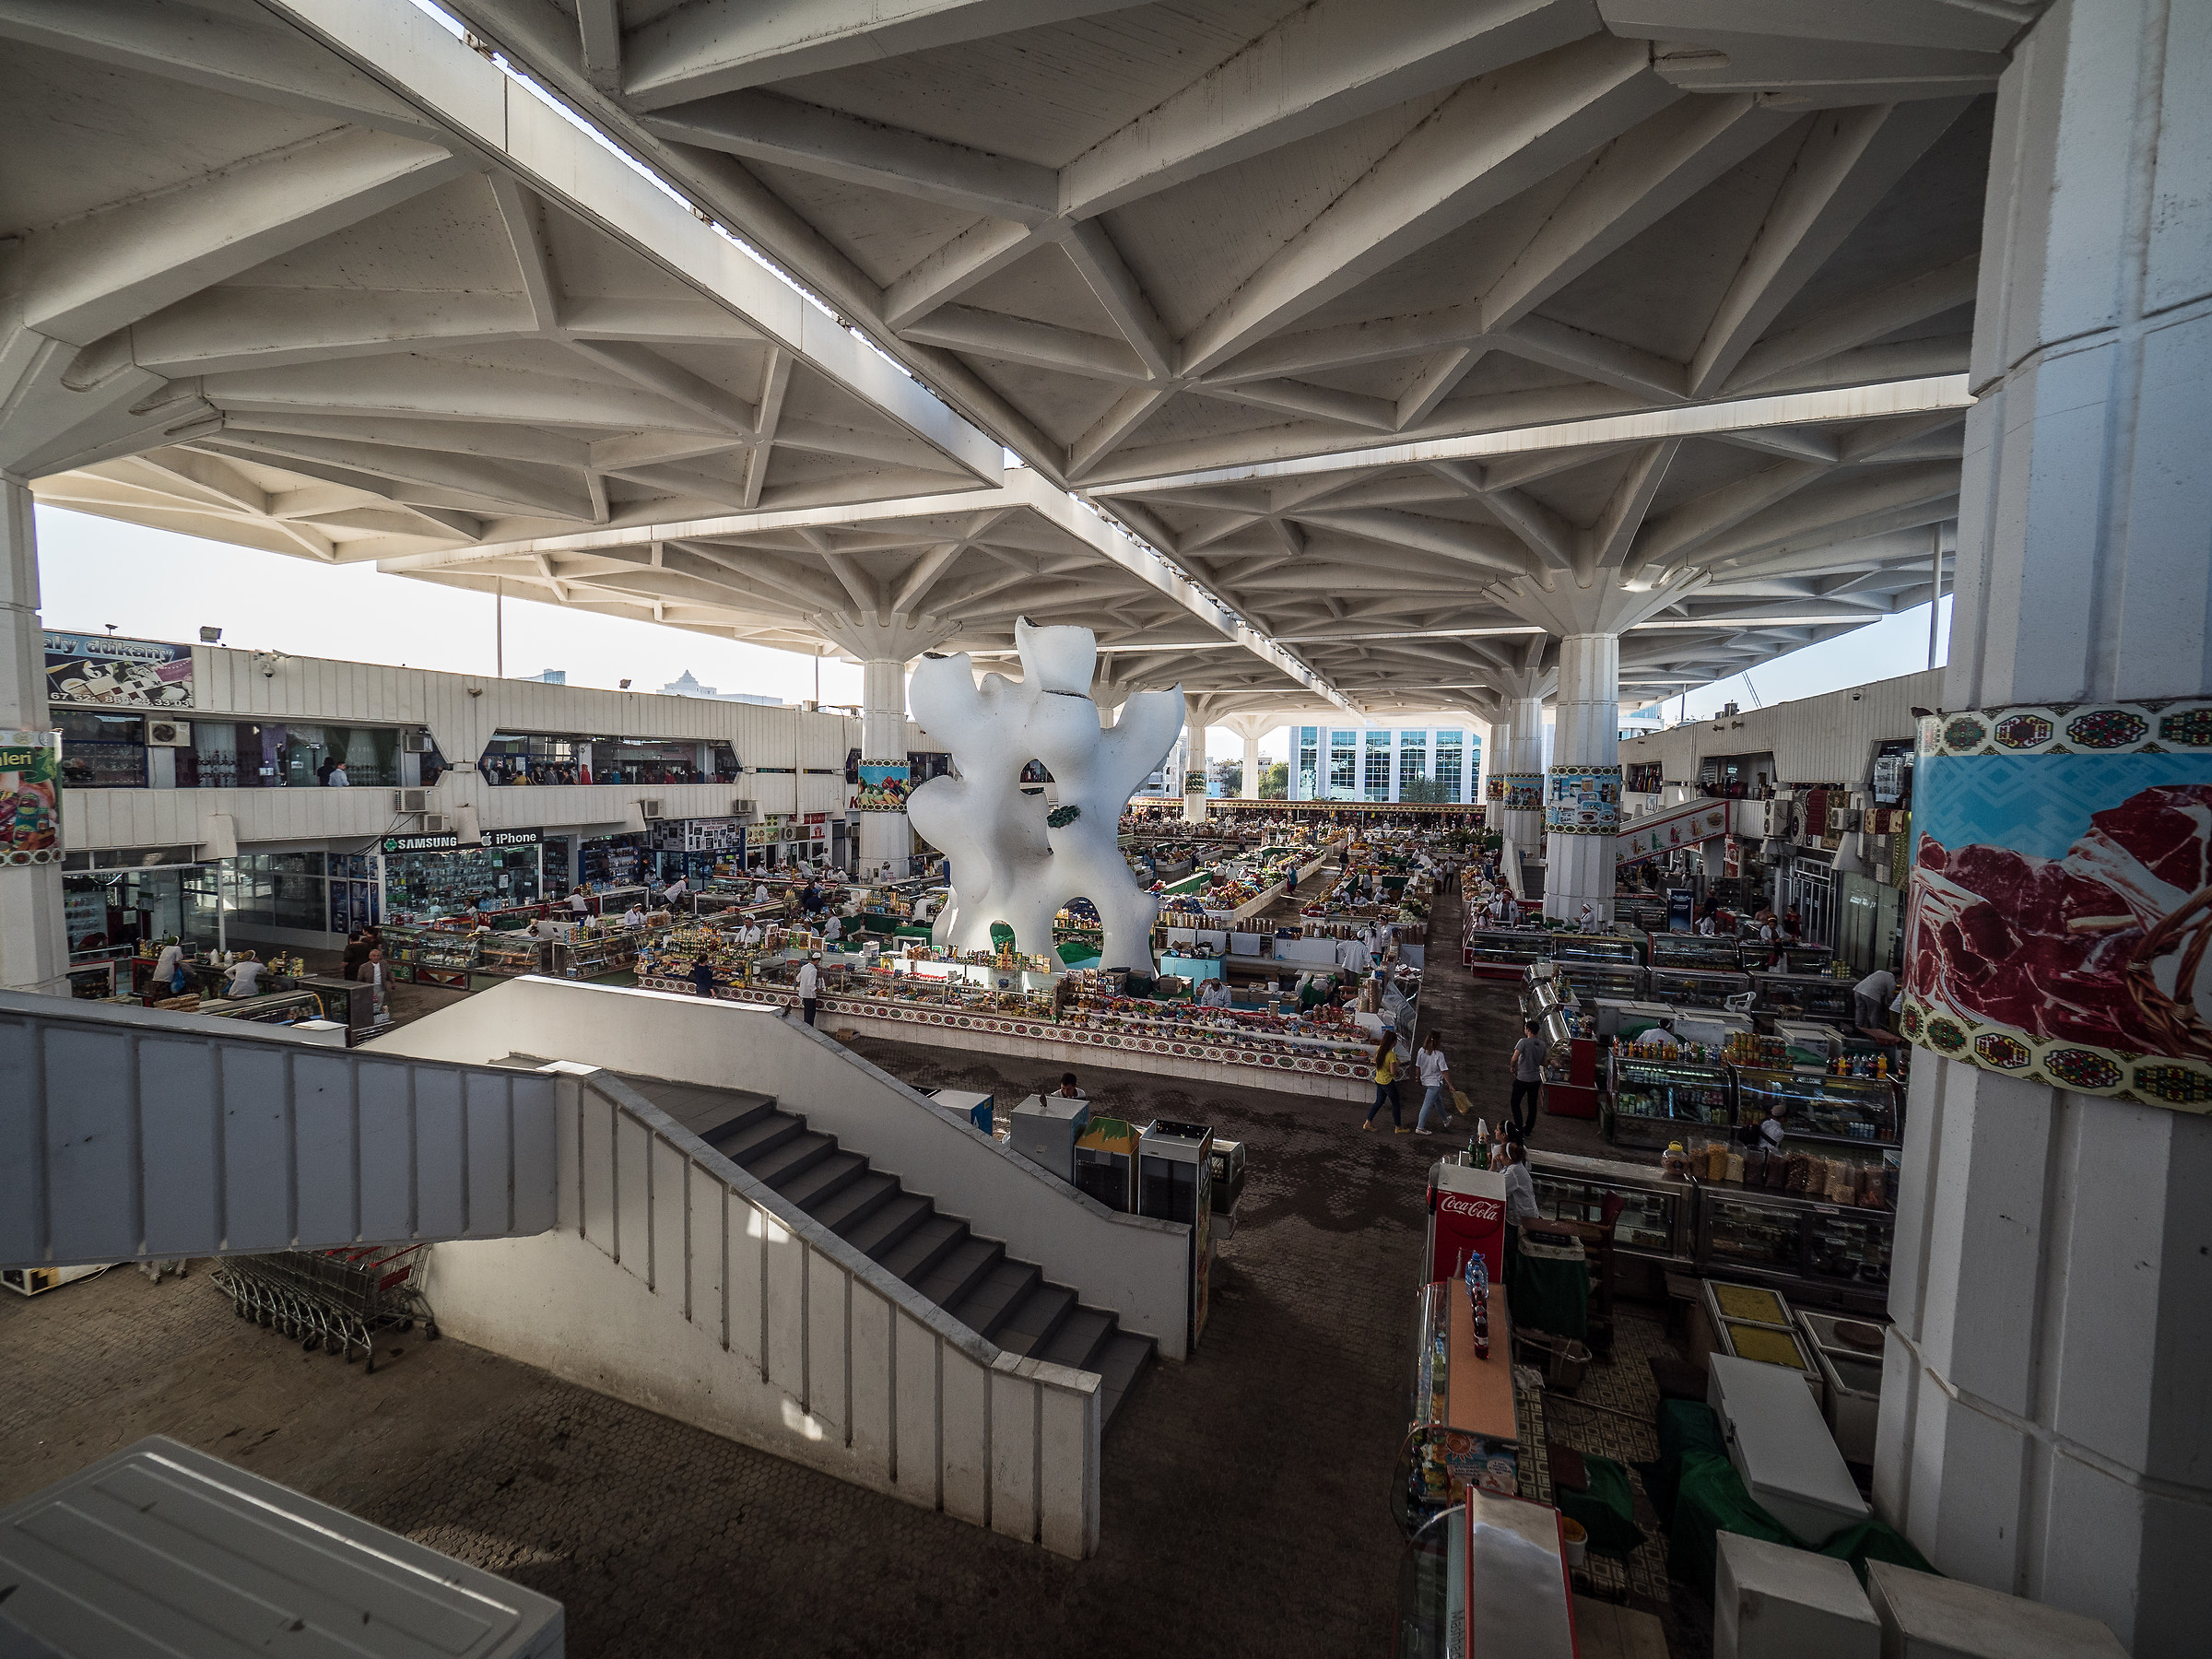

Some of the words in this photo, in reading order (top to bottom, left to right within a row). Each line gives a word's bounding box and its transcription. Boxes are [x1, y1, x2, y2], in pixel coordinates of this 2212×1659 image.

[86, 639, 174, 663] dükany
[0, 750, 31, 766] leri
[397, 837, 457, 850] SAMSUNG
[496, 832, 536, 845] iPhone
[1441, 1195, 1500, 1220] Coca-Cola
